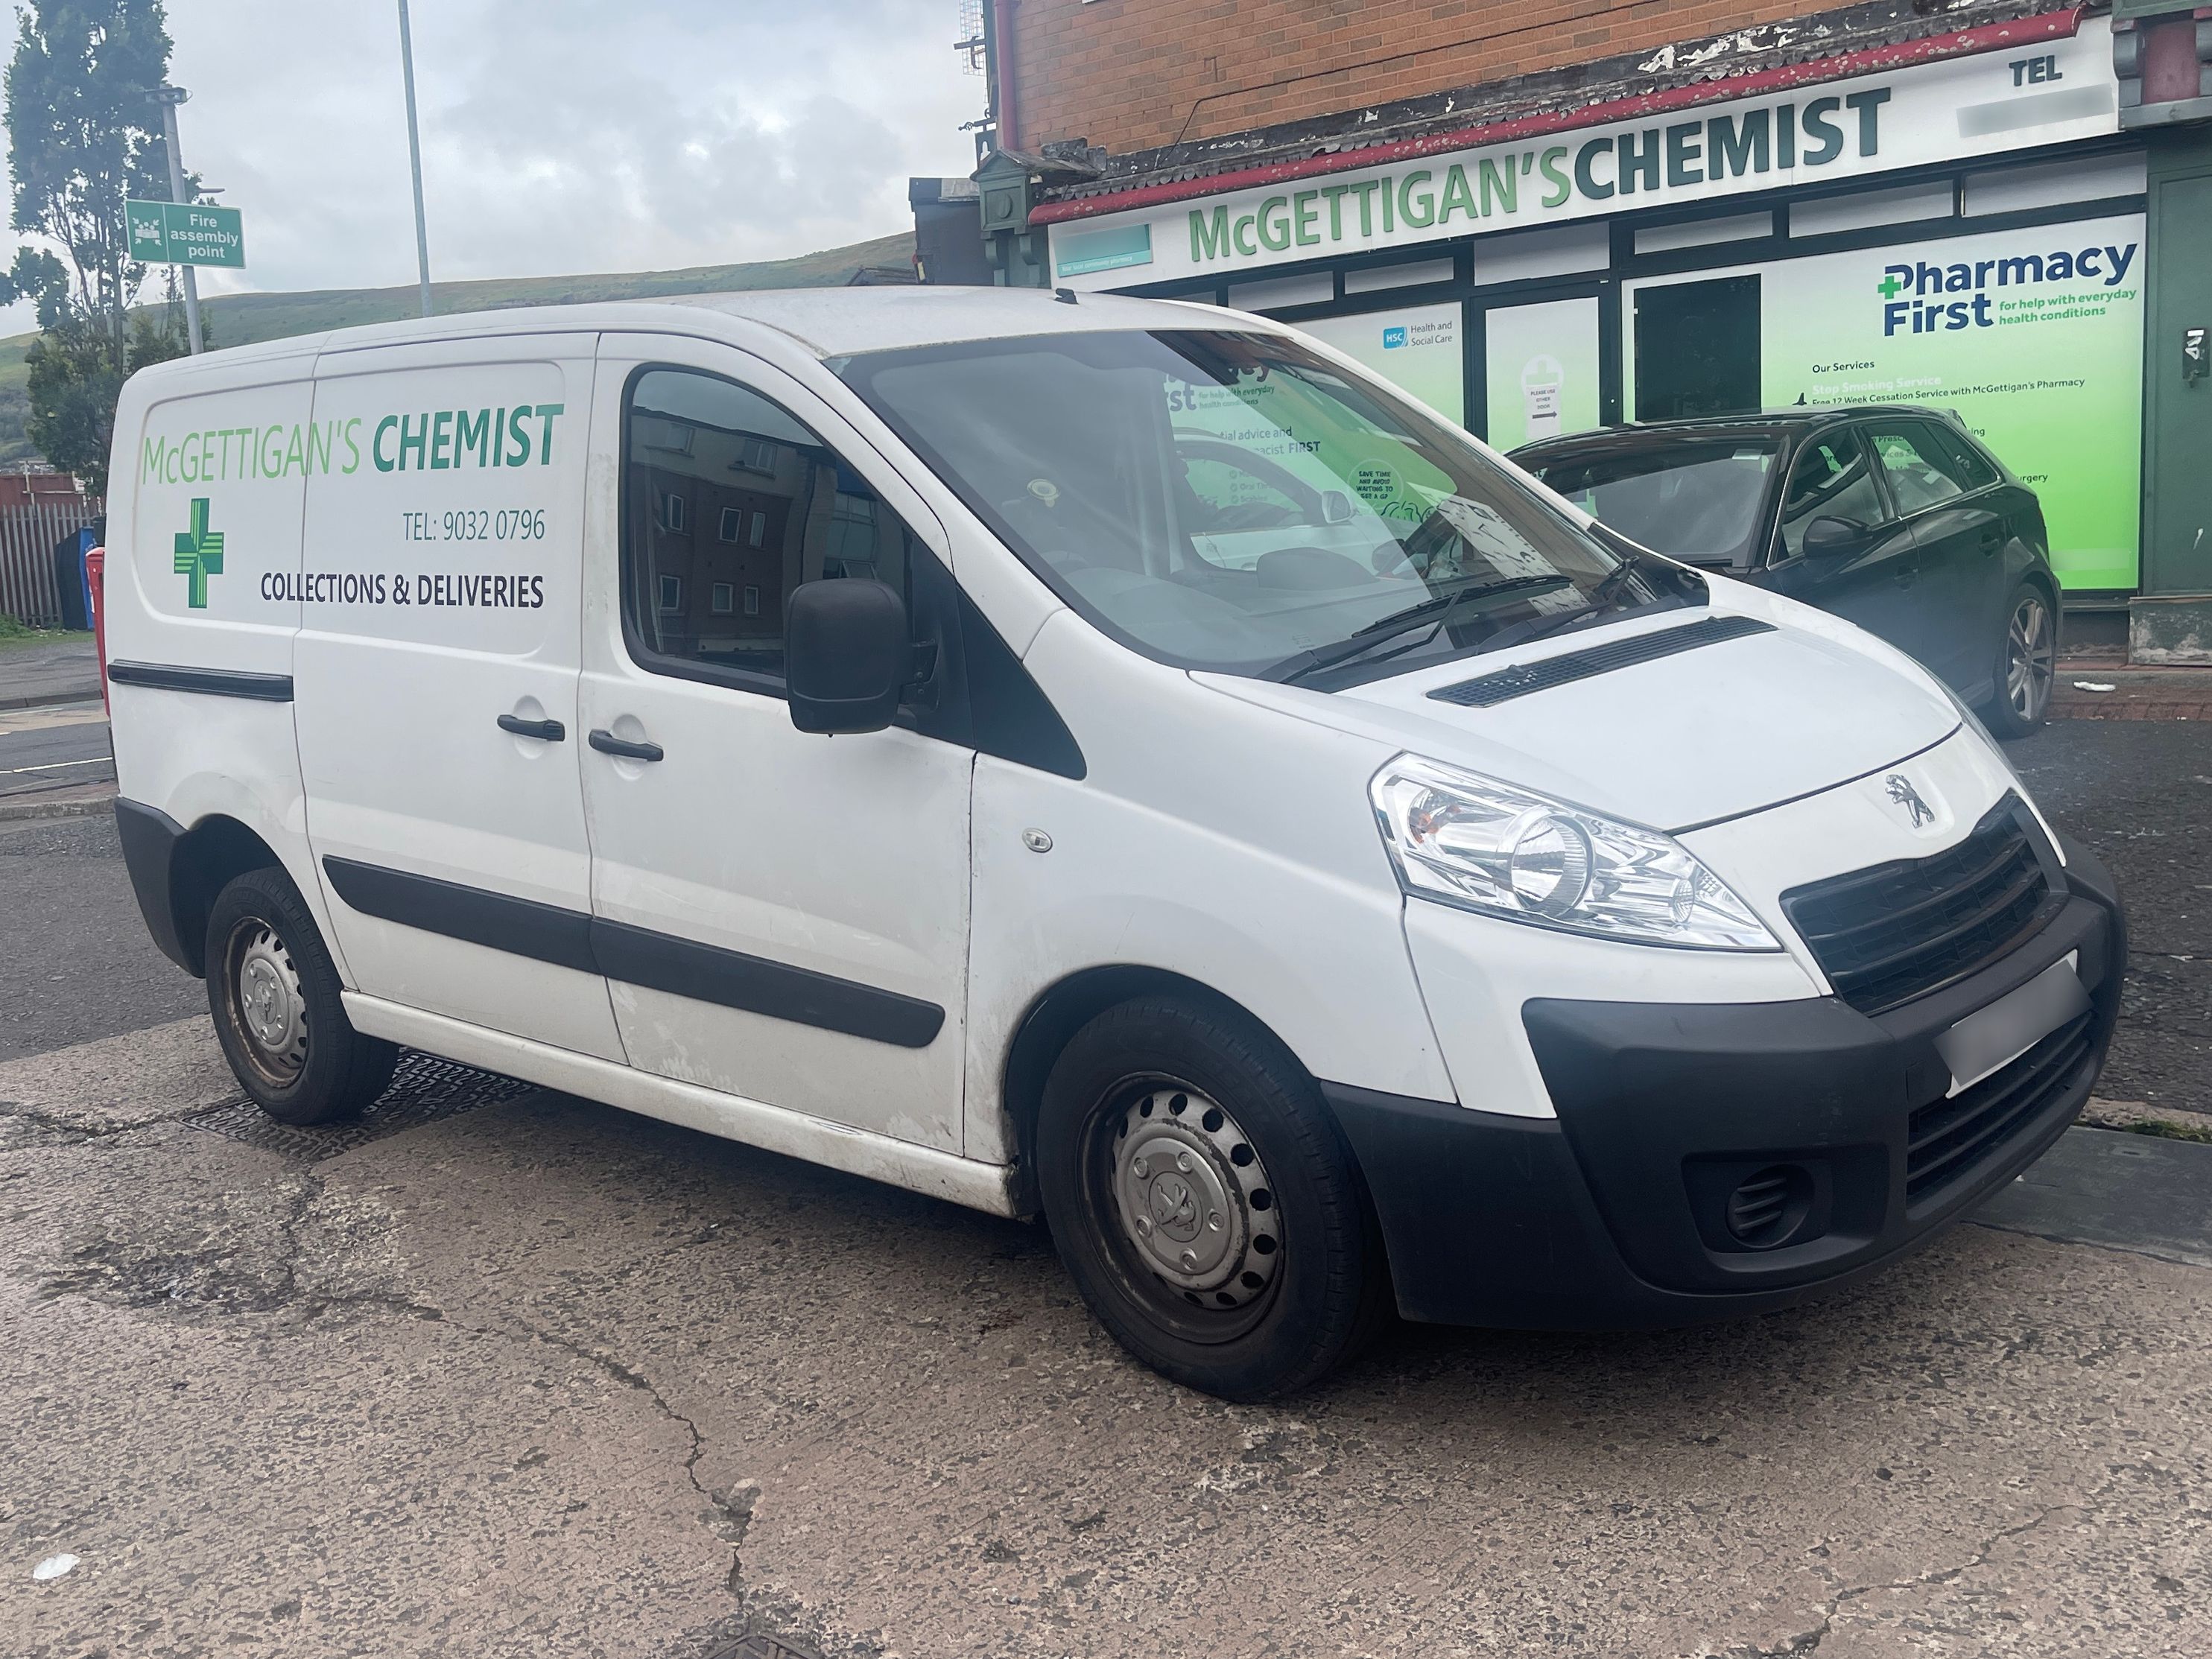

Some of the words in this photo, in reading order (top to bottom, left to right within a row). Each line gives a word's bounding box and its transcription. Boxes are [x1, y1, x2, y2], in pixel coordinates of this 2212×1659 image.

[2008, 54, 2063, 87] TEL
[1188, 145, 1572, 262] McGETTIGAN'S
[1574, 86, 1891, 200] CHEMIST
[189, 213, 218, 228] Fire
[170, 230, 239, 247] assembly
[188, 244, 226, 258] point
[1884, 243, 2138, 296] Pharmacy
[2000, 301, 2017, 311] for
[2019, 297, 2045, 310] help
[2048, 294, 2076, 306] with
[2078, 288, 2137, 302] everyday
[1883, 293, 1994, 337] First
[1999, 312, 2038, 326] health
[2040, 307, 2106, 321] conditions
[1410, 323, 1436, 333] Health
[1437, 320, 1452, 330] and
[1387, 332, 1403, 343] HSC
[1411, 335, 1433, 346] Social
[1435, 334, 1453, 343] Care
[1812, 364, 1831, 373] Our
[1833, 361, 1875, 372] Services
[1242, 384, 1275, 396] everyday
[1812, 384, 1839, 396] Stop
[1842, 378, 1894, 393] Smoking
[1896, 375, 1942, 388] Service
[1844, 396, 1868, 404] Week
[1869, 392, 1913, 403] Cessation
[1915, 388, 1949, 399] Service
[1950, 387, 1971, 396] with
[1973, 381, 2035, 393] McGettigan's
[2037, 378, 2085, 389] Pharmacy
[1237, 429, 1271, 440] advice
[1273, 425, 1292, 437] and
[1970, 427, 1986, 437] ing
[142, 417, 362, 485] McGETTIGAN'S
[373, 403, 565, 472] CHEMIST
[1288, 440, 1321, 454] FIRST
[402, 512, 437, 541] TEL:
[443, 510, 489, 541] 9032
[495, 509, 545, 540] 0796
[261, 572, 387, 605] COLLECTIONS
[392, 574, 411, 605] &
[417, 574, 544, 609] DELIVERIES
